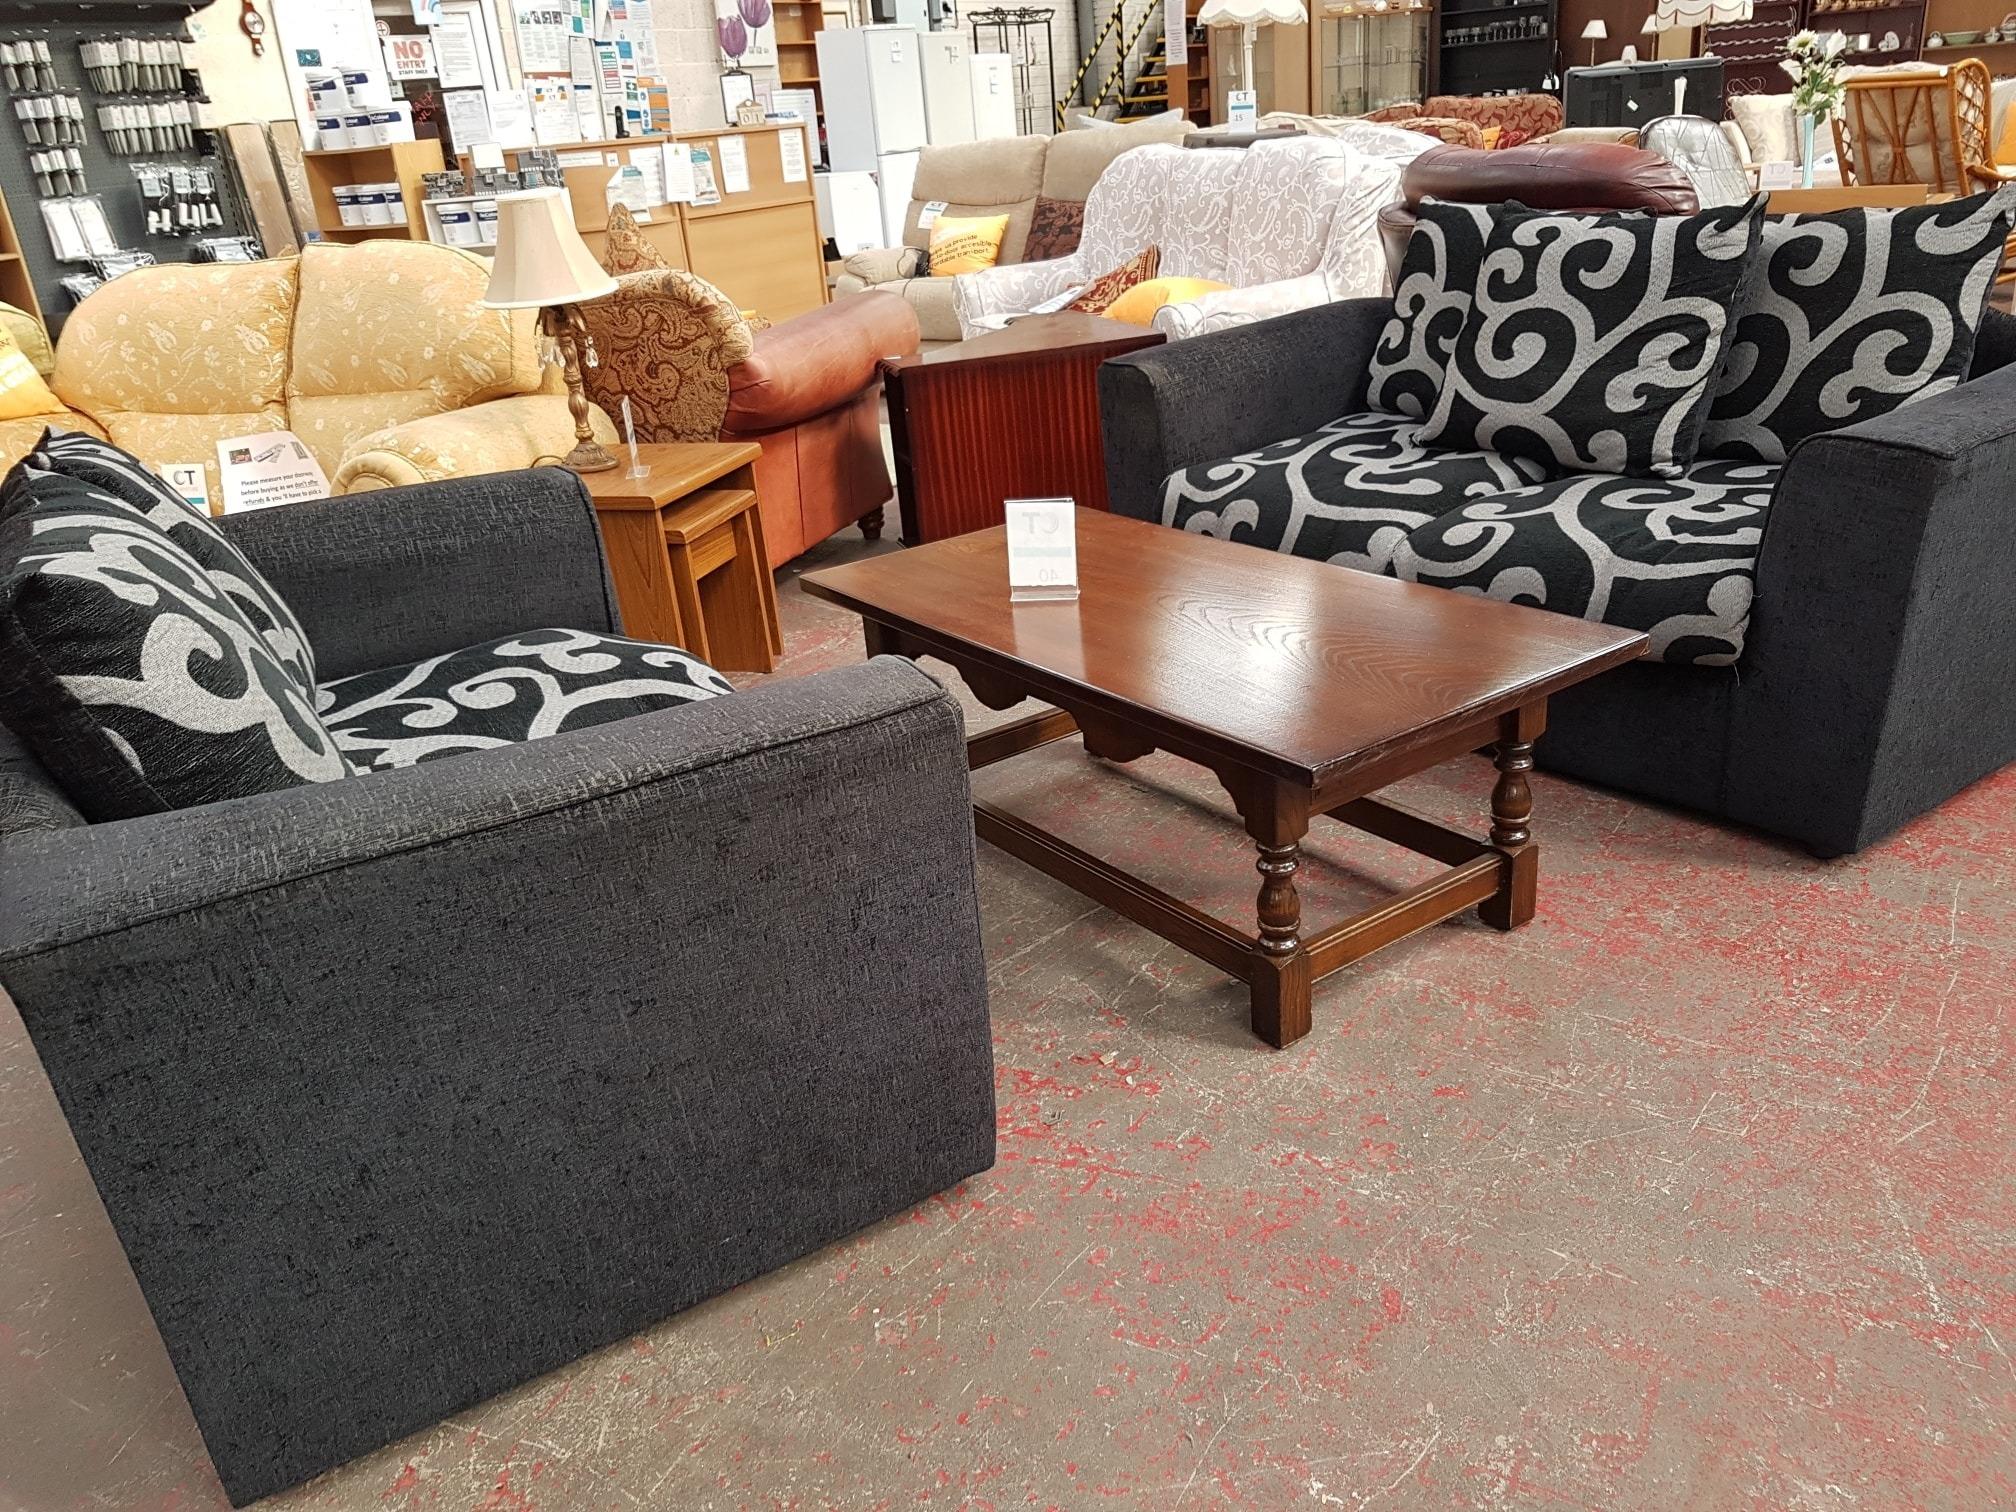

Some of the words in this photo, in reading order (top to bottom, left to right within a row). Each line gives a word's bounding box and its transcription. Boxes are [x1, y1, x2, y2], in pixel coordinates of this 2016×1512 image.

[393, 41, 424, 59] NO
[397, 60, 426, 69] ENTRY
[1235, 92, 1249, 101] CT
[173, 470, 196, 485] CT
